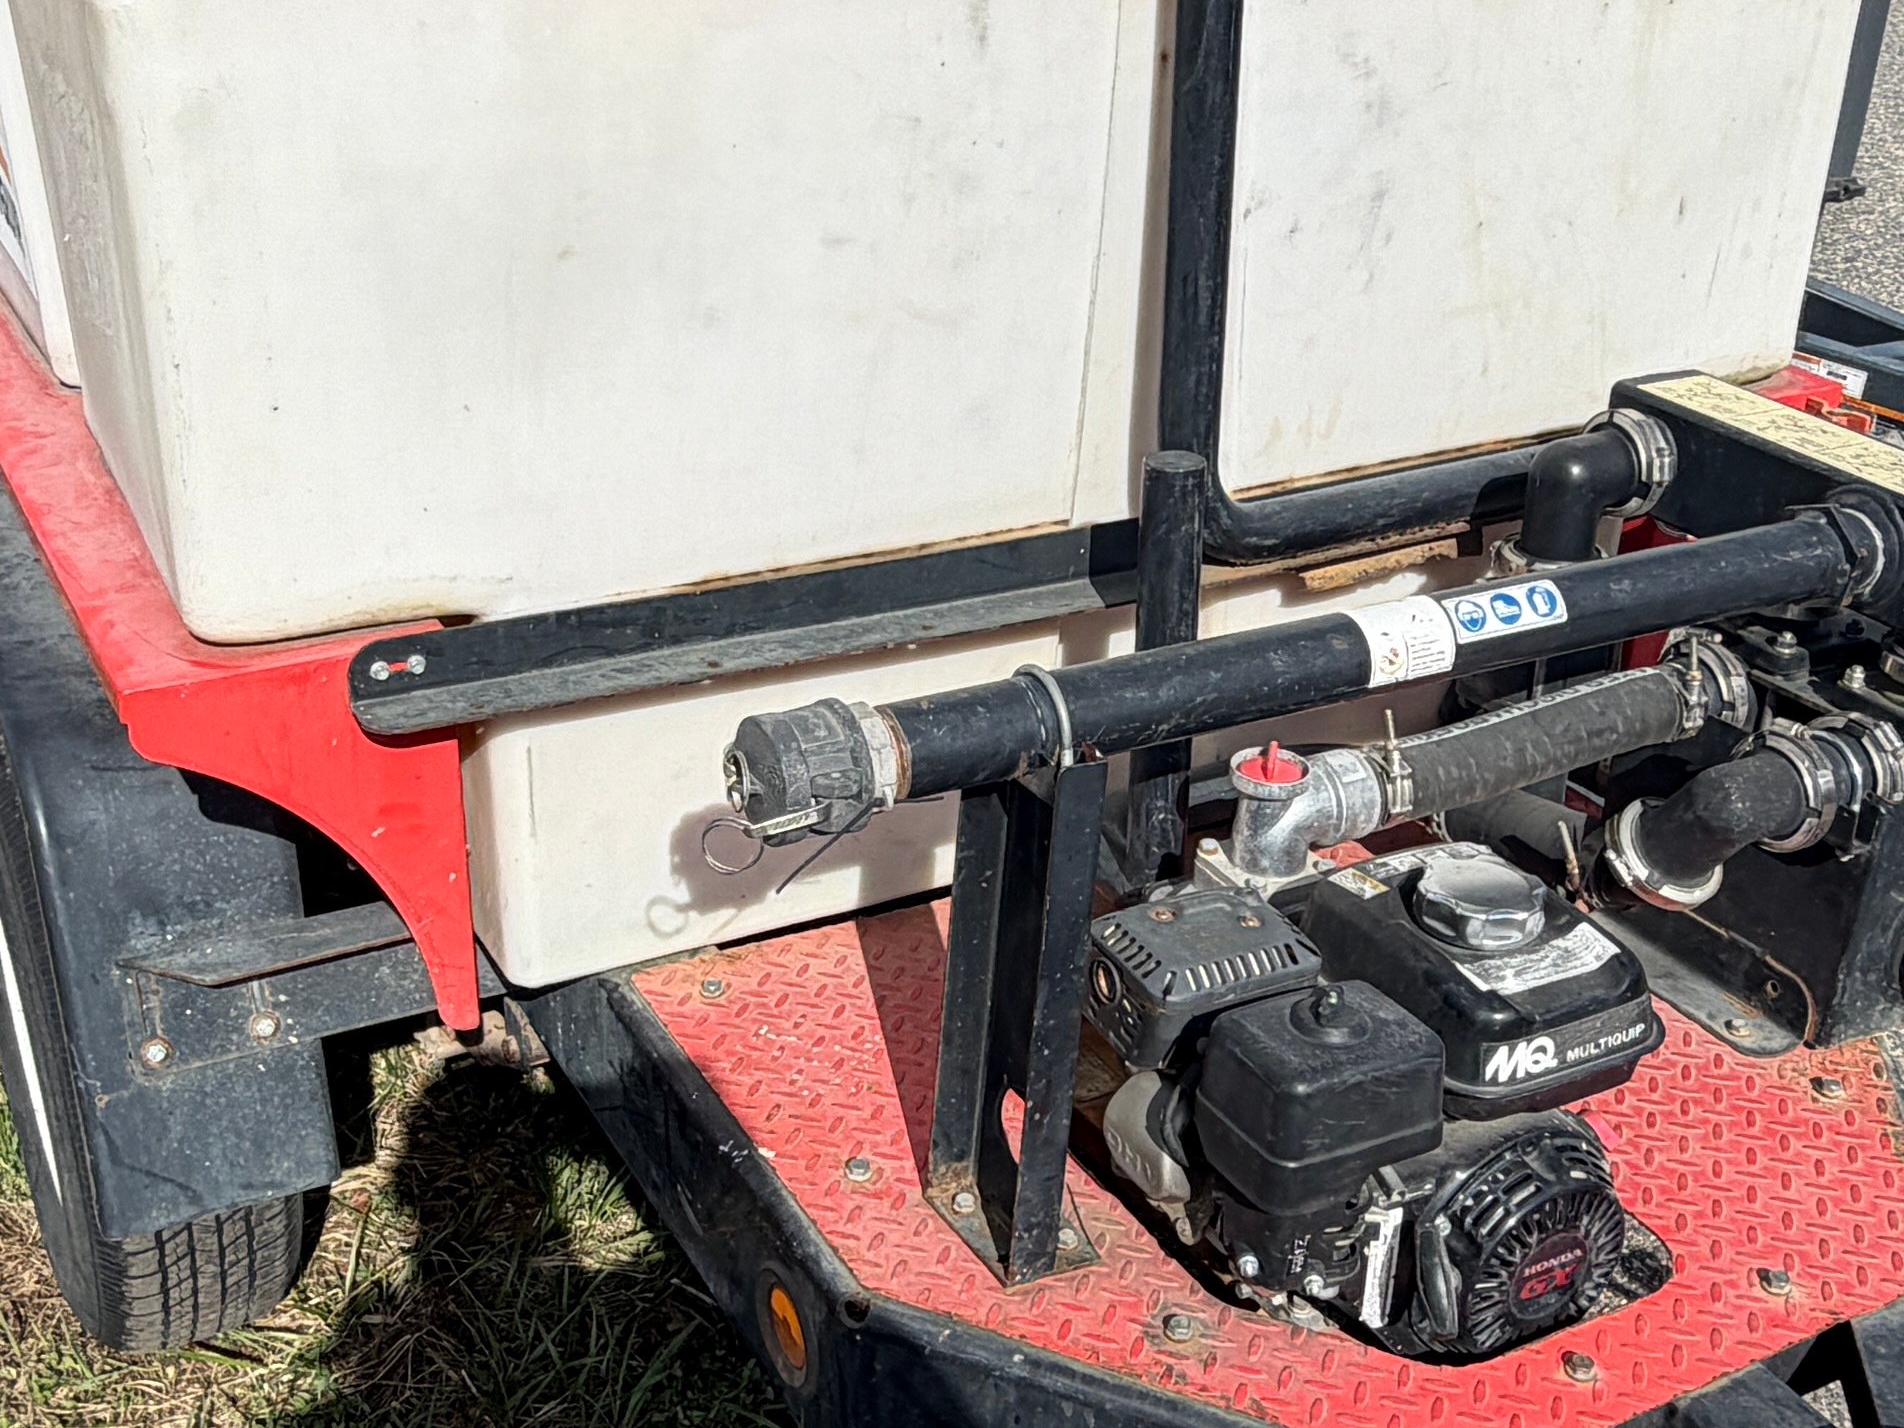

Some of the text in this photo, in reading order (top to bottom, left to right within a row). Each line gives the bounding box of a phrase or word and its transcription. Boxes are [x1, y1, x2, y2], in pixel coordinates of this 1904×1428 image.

[1484, 1022, 1646, 1083] MQ MULTIQUIP
[1524, 1248, 1584, 1277] HONDA
[1520, 1263, 1578, 1301] GX
